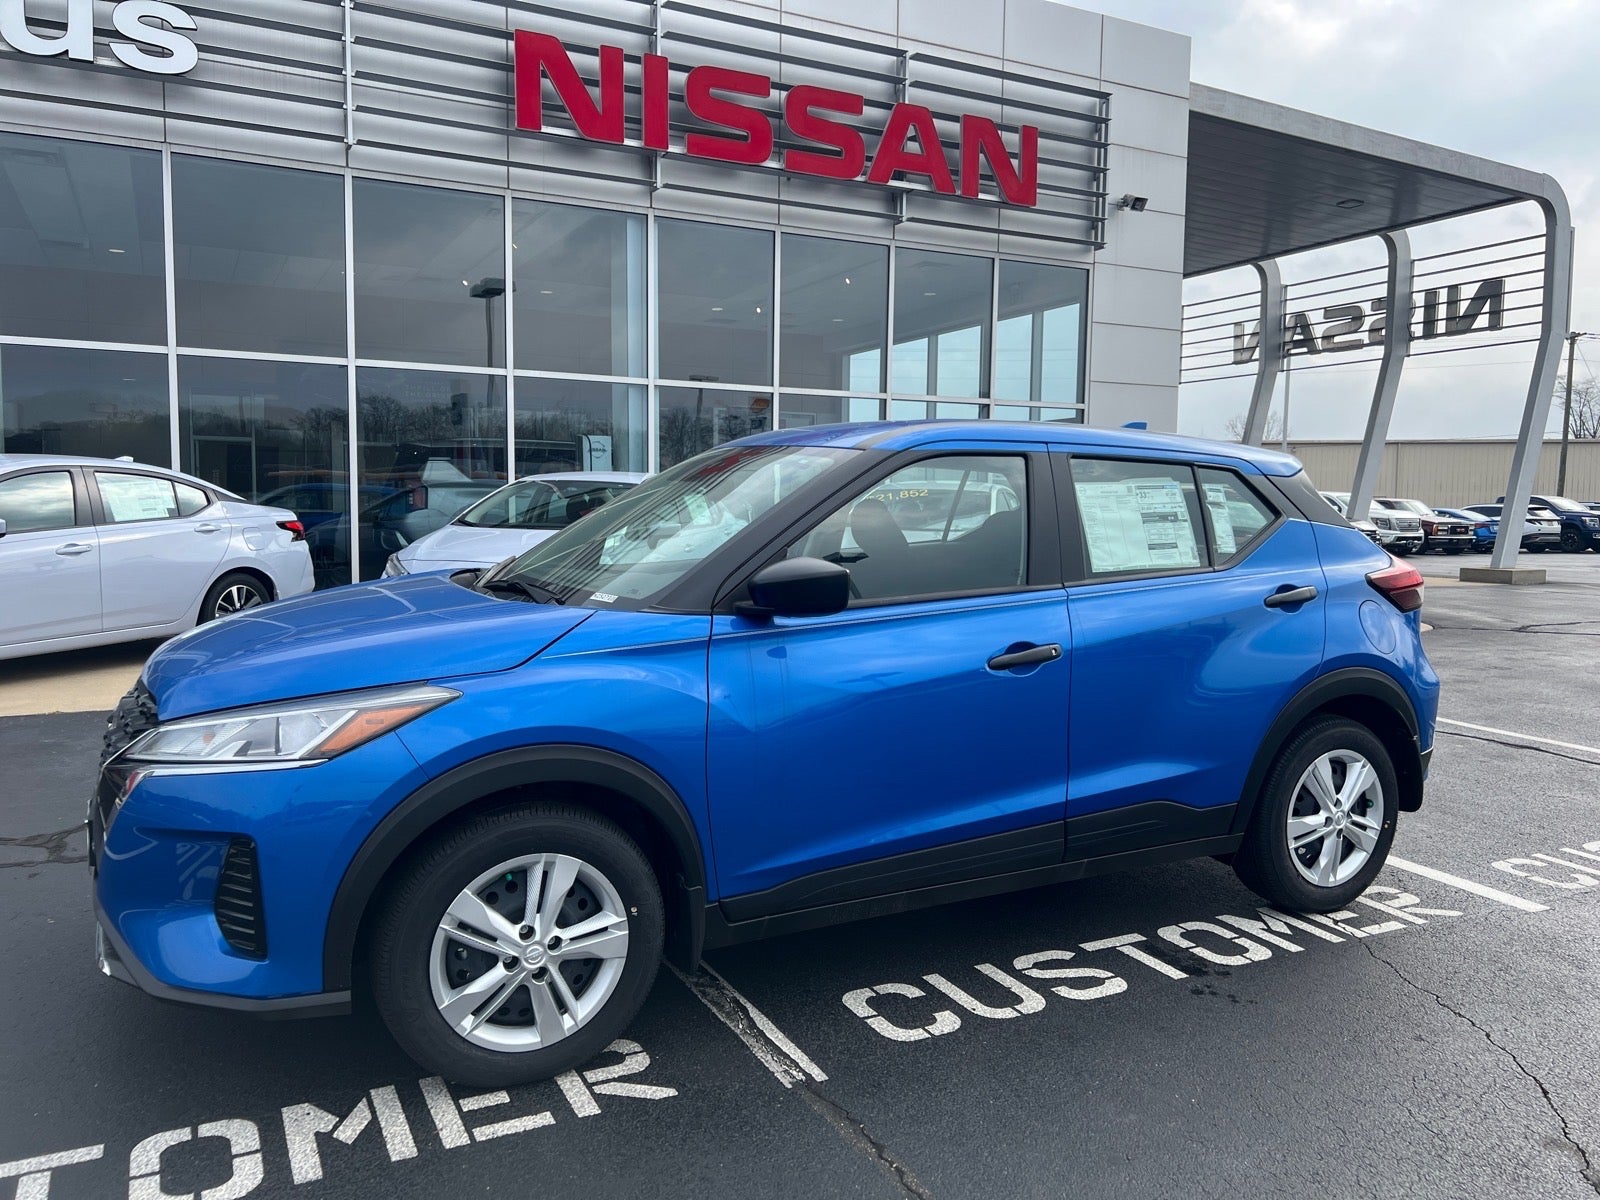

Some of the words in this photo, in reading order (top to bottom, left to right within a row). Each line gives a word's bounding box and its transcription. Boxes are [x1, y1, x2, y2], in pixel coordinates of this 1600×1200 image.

[0, 0, 199, 75] us
[514, 29, 1039, 207] NISSAN
[1491, 840, 1600, 889] CU
[842, 885, 1464, 1042] CUSTOMER
